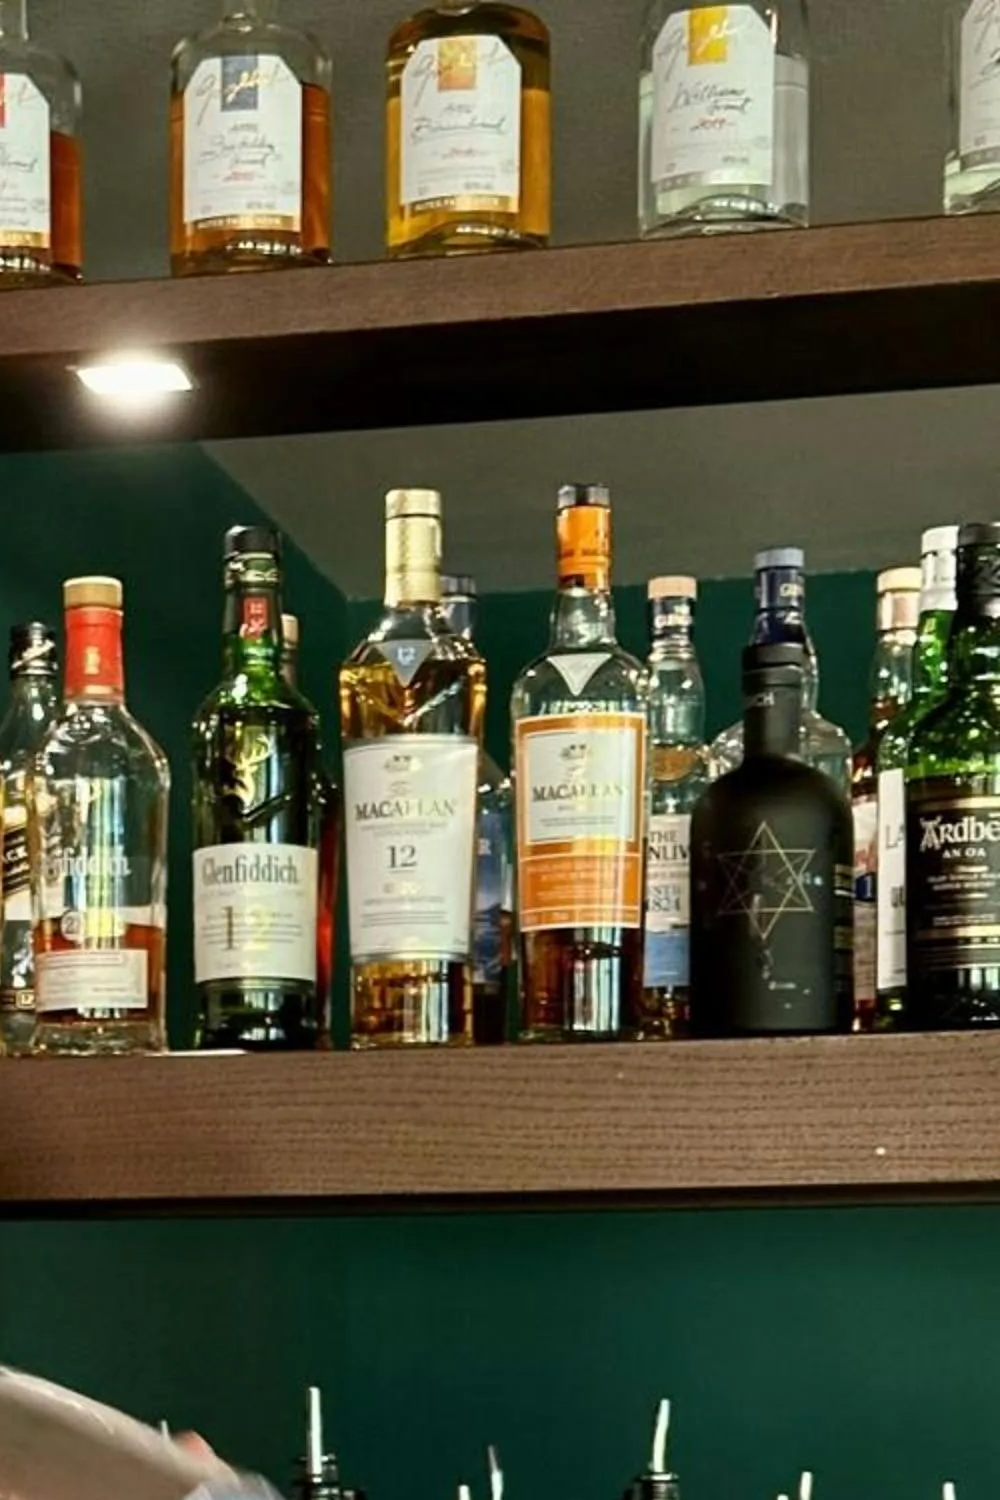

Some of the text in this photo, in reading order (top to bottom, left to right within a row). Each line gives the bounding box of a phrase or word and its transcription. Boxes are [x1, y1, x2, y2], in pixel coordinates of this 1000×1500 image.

[919, 815, 1000, 852] Ardbe
[387, 844, 418, 870] 12
[942, 848, 961, 859] AN
[201, 853, 301, 887] Glenfiddich
